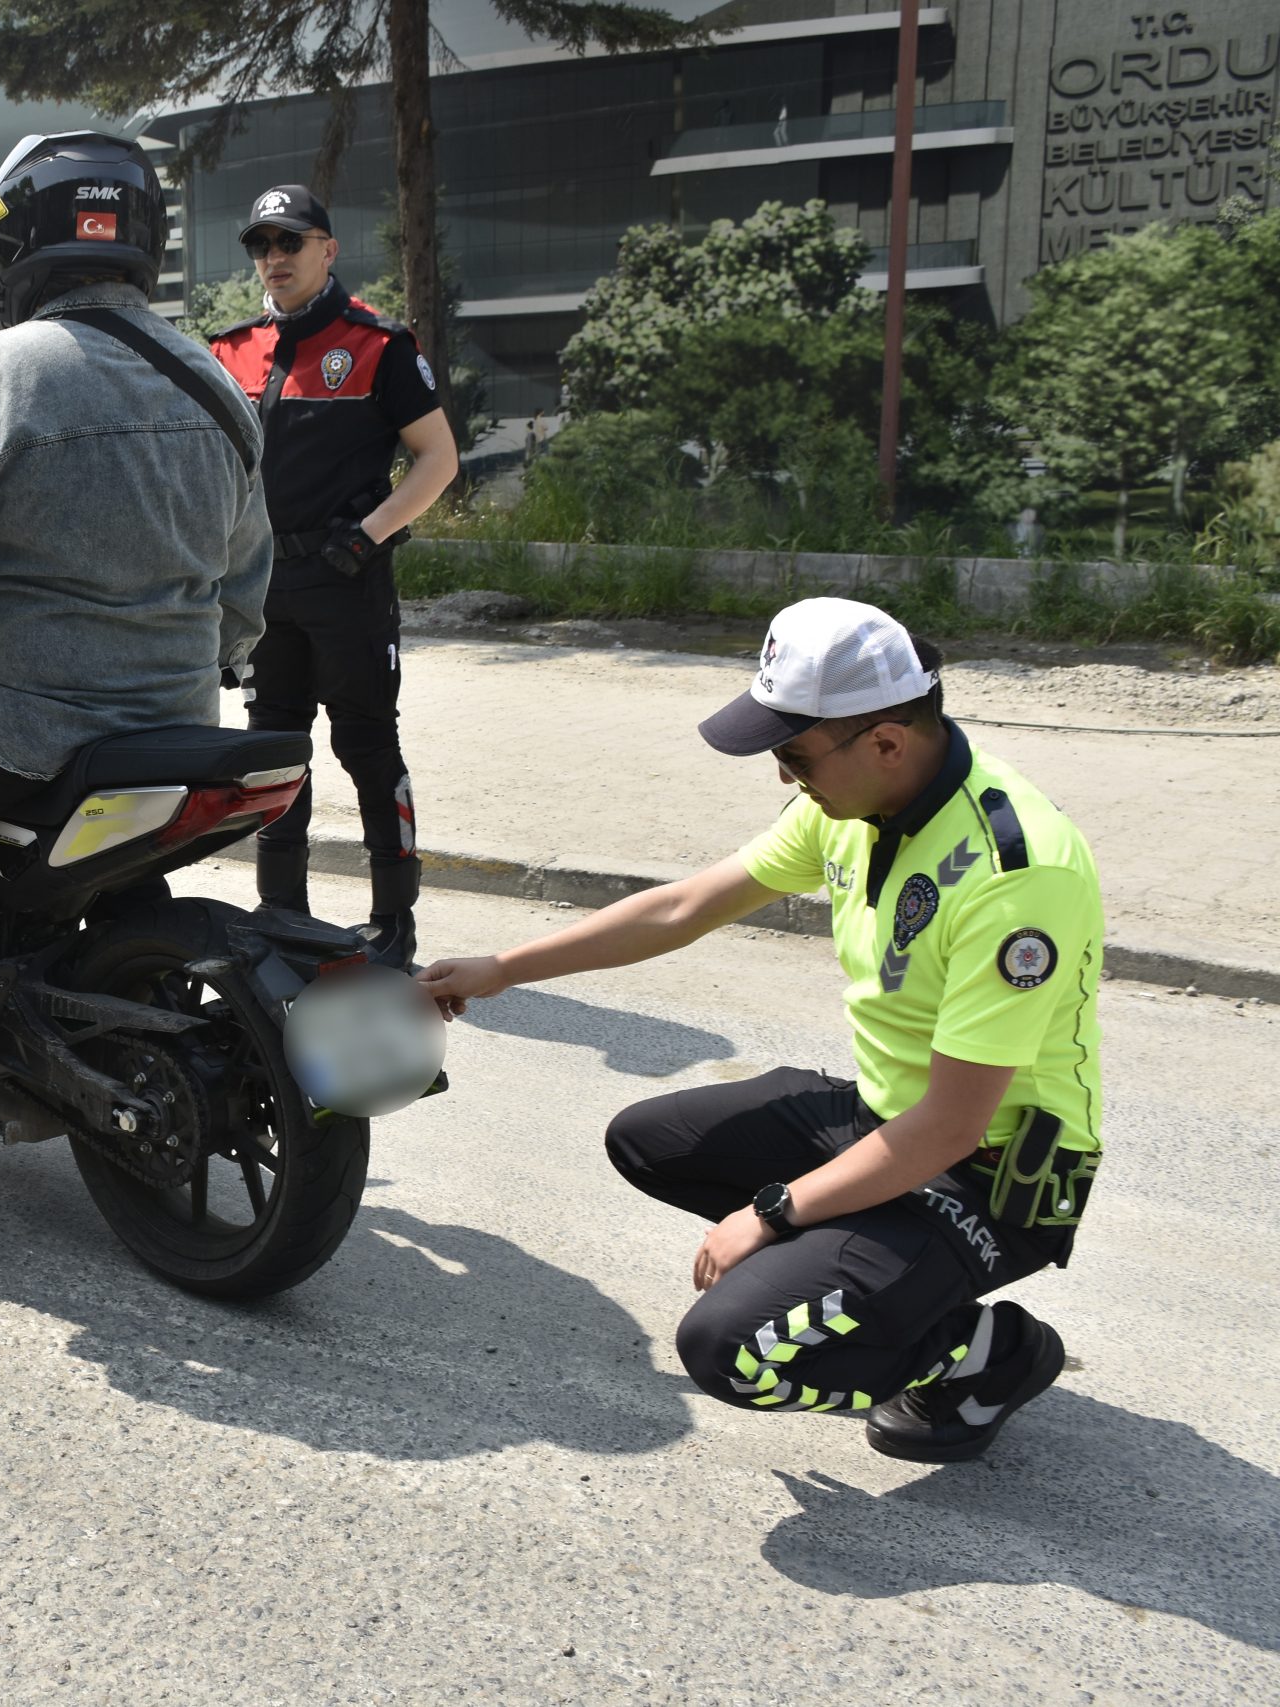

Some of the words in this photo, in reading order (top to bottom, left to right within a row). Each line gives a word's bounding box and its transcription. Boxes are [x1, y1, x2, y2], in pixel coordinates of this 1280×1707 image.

[1131, 12, 1194, 40] T.C.
[1050, 33, 1279, 100] ORDU
[1046, 87, 1270, 135] BÜYÜKŞEHİR
[1045, 119, 1269, 168] BELEDİYESİ
[74, 186, 123, 201] SMK
[1042, 155, 1265, 219] KÜLTÜR
[85, 808, 105, 817] 250
